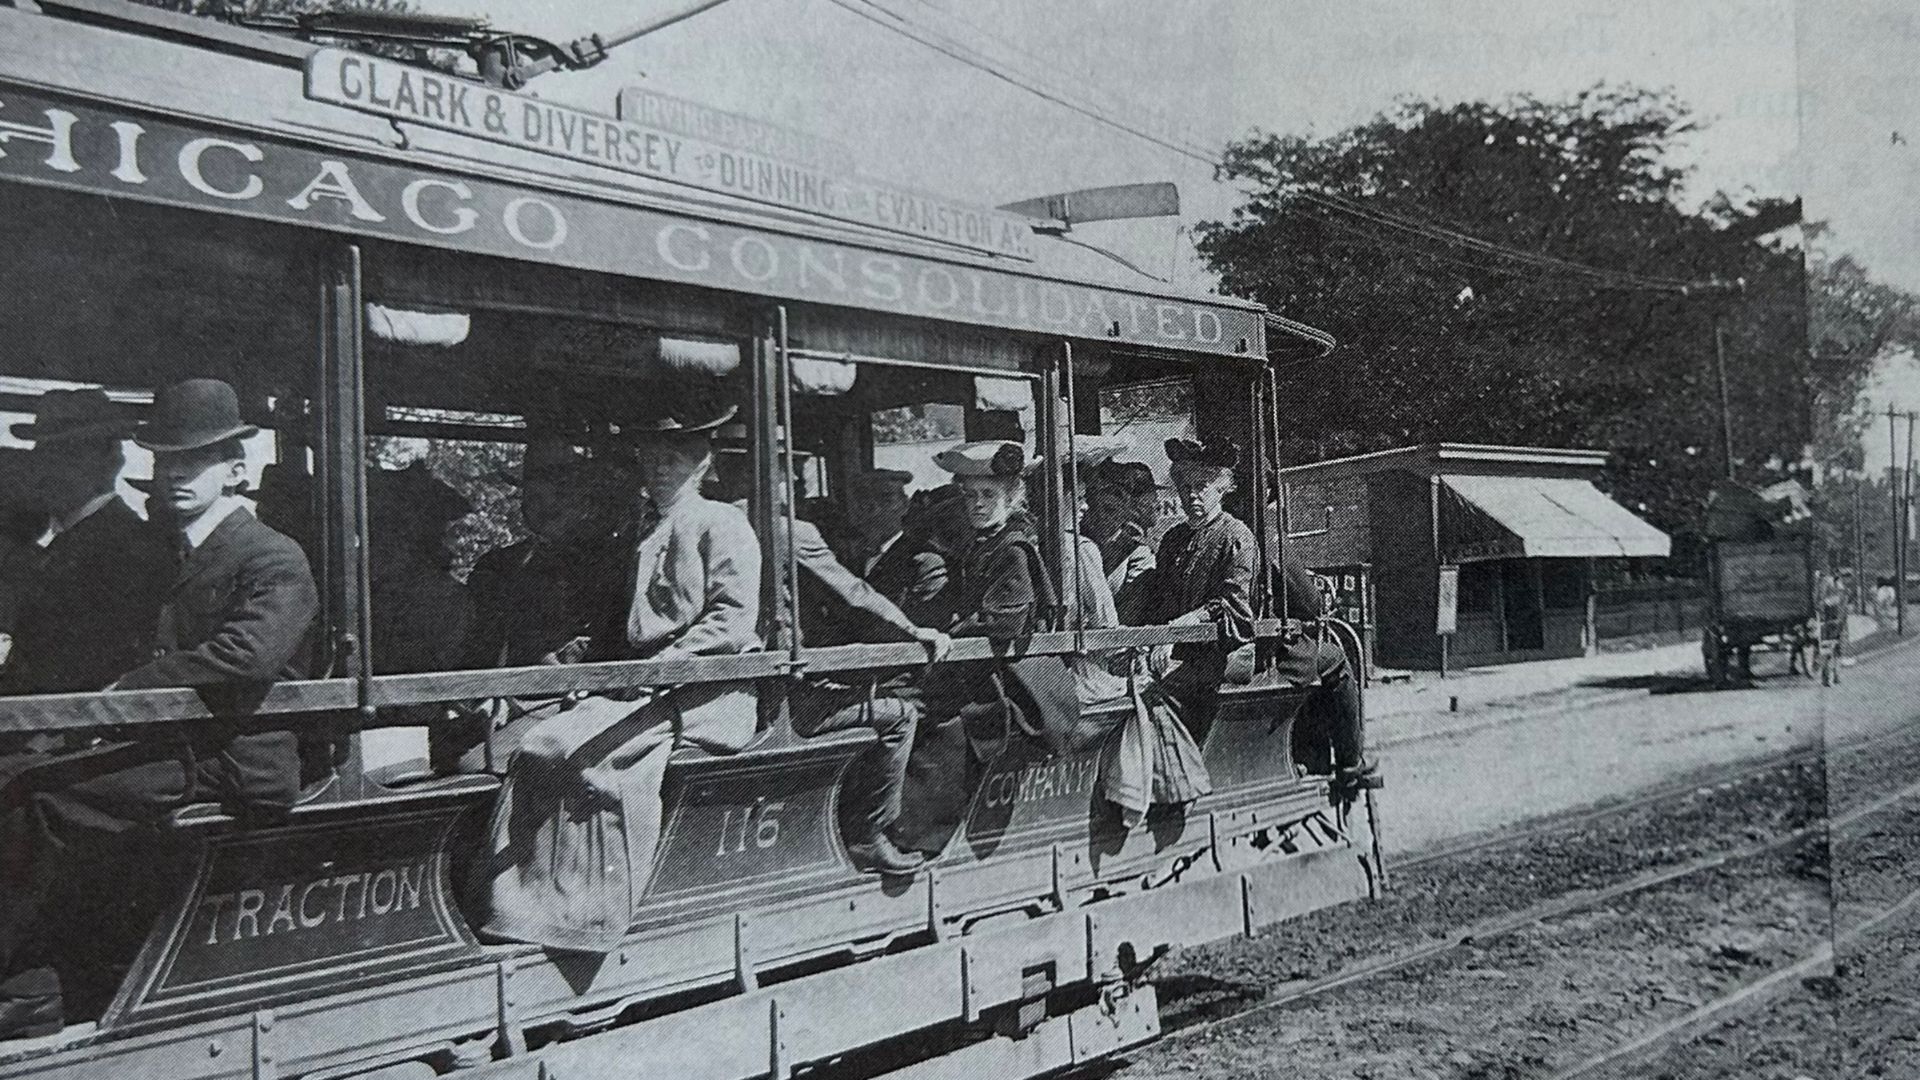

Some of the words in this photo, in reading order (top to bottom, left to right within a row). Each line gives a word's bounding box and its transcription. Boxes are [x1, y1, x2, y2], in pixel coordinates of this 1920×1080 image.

[339, 56, 472, 128] CLARK
[483, 94, 509, 137] &
[522, 101, 683, 174] DIVERSEY
[719, 152, 836, 210] DUNNING
[875, 189, 993, 246] EVANSTON
[656, 225, 1222, 346] CONSOLIDATED
[985, 759, 1092, 809] COMPANY
[715, 802, 784, 857] 116
[204, 860, 429, 945] TRACTION
